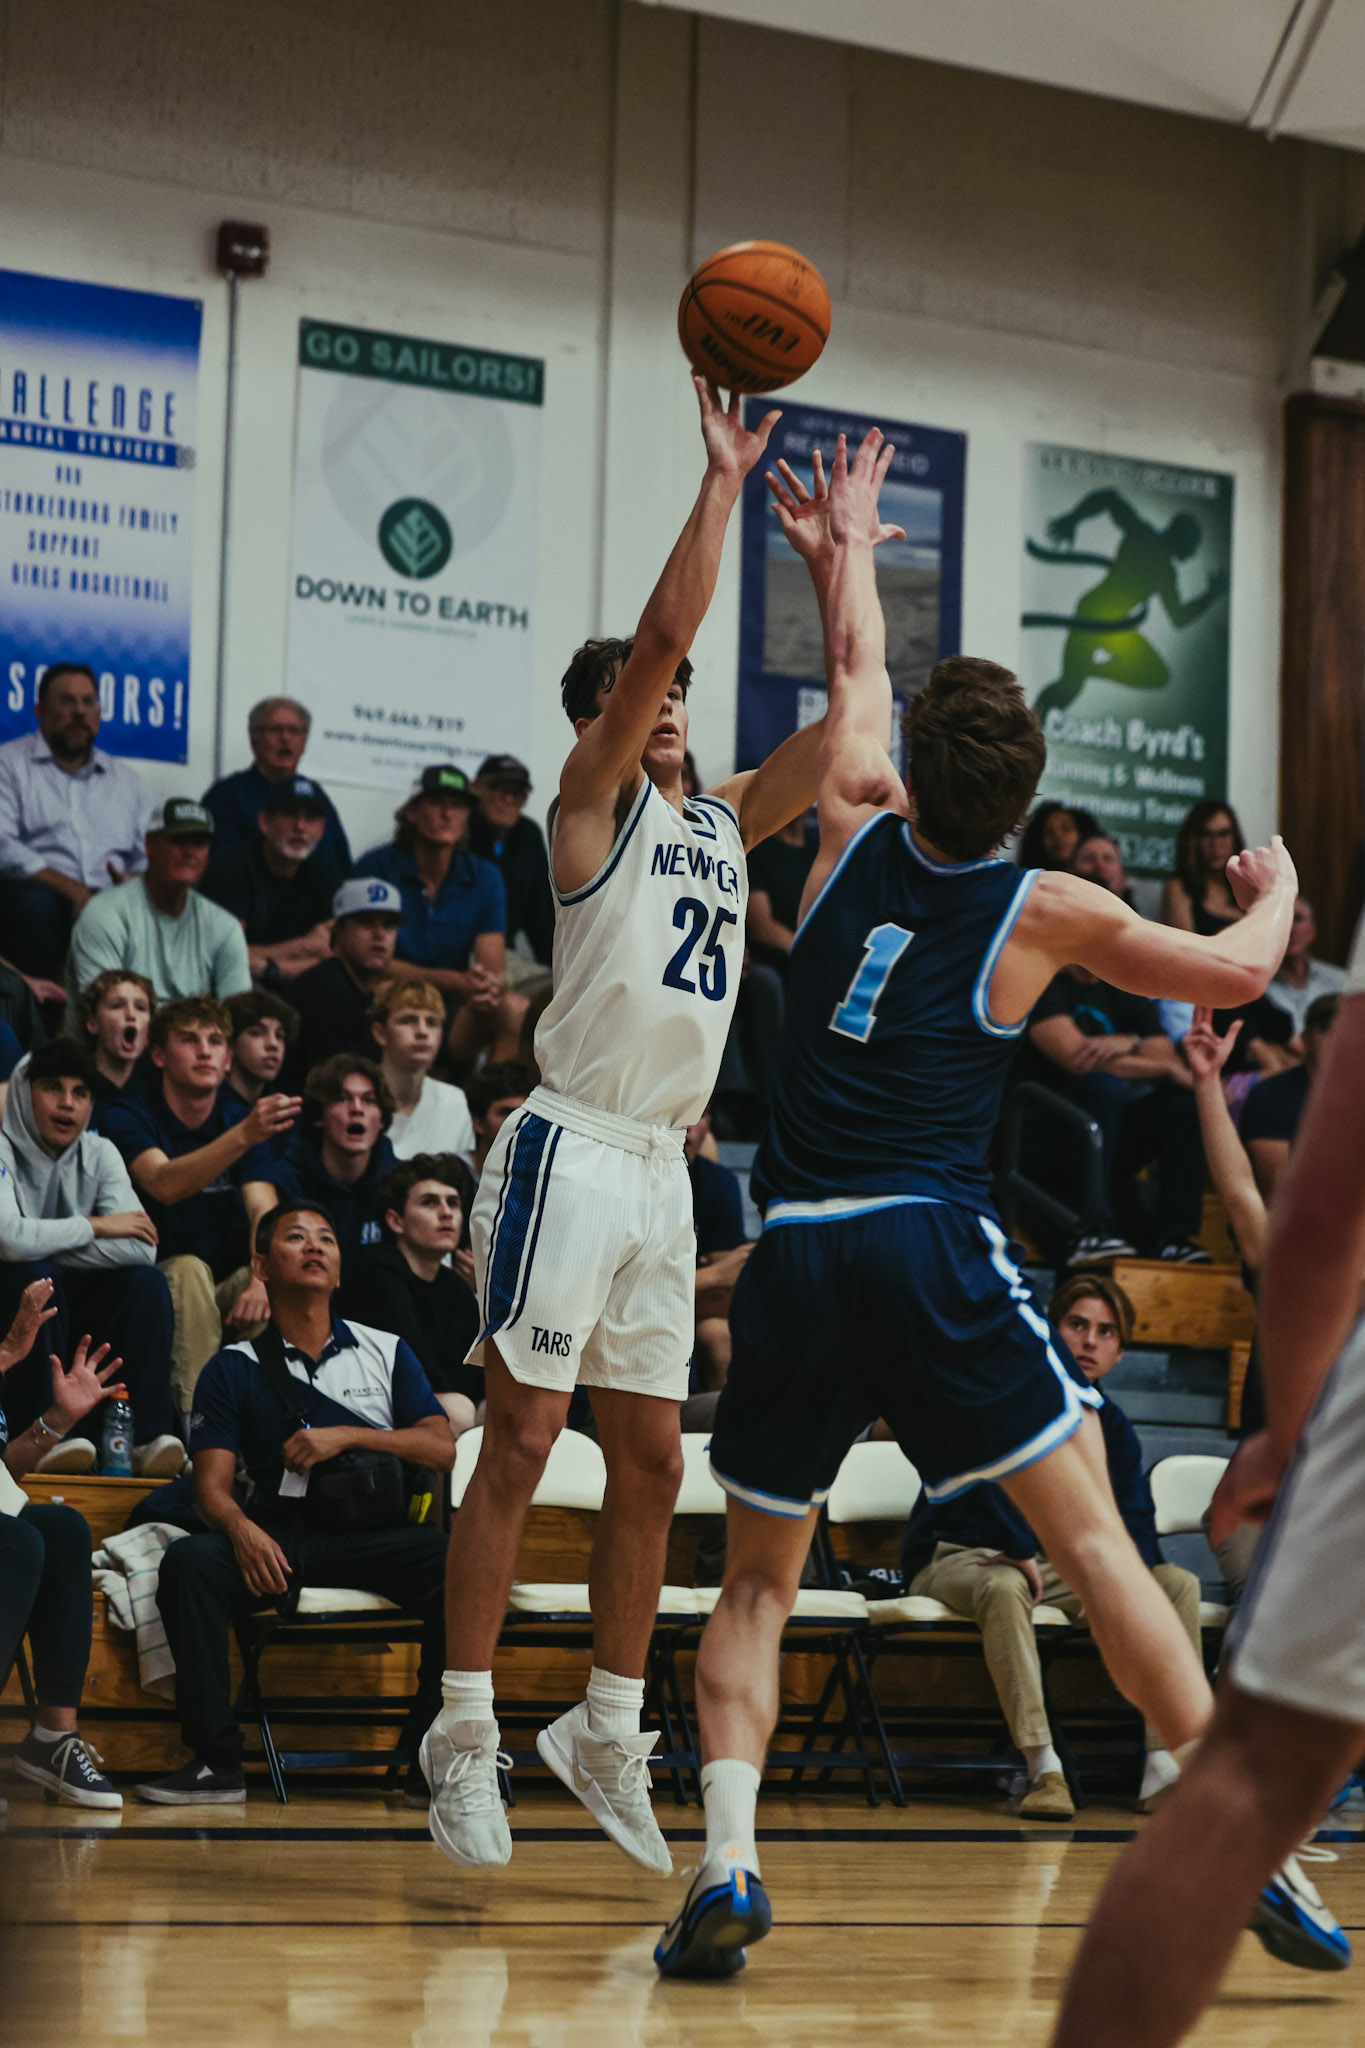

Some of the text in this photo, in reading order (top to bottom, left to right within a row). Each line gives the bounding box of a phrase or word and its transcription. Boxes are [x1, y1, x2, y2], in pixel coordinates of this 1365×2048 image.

[306, 328, 537, 395] GO SAILORS!
[0, 368, 176, 438] ALLENGE
[27, 528, 99, 561] SUPPORT
[11, 561, 60, 592] GIRLS
[295, 574, 387, 611] DOWN
[394, 588, 431, 617] TO
[437, 596, 529, 632] EARTH
[1044, 706, 1206, 763] Coach Byrd's
[661, 896, 738, 1002] 25
[827, 921, 916, 1045] 1
[531, 1325, 573, 1358] TARS
